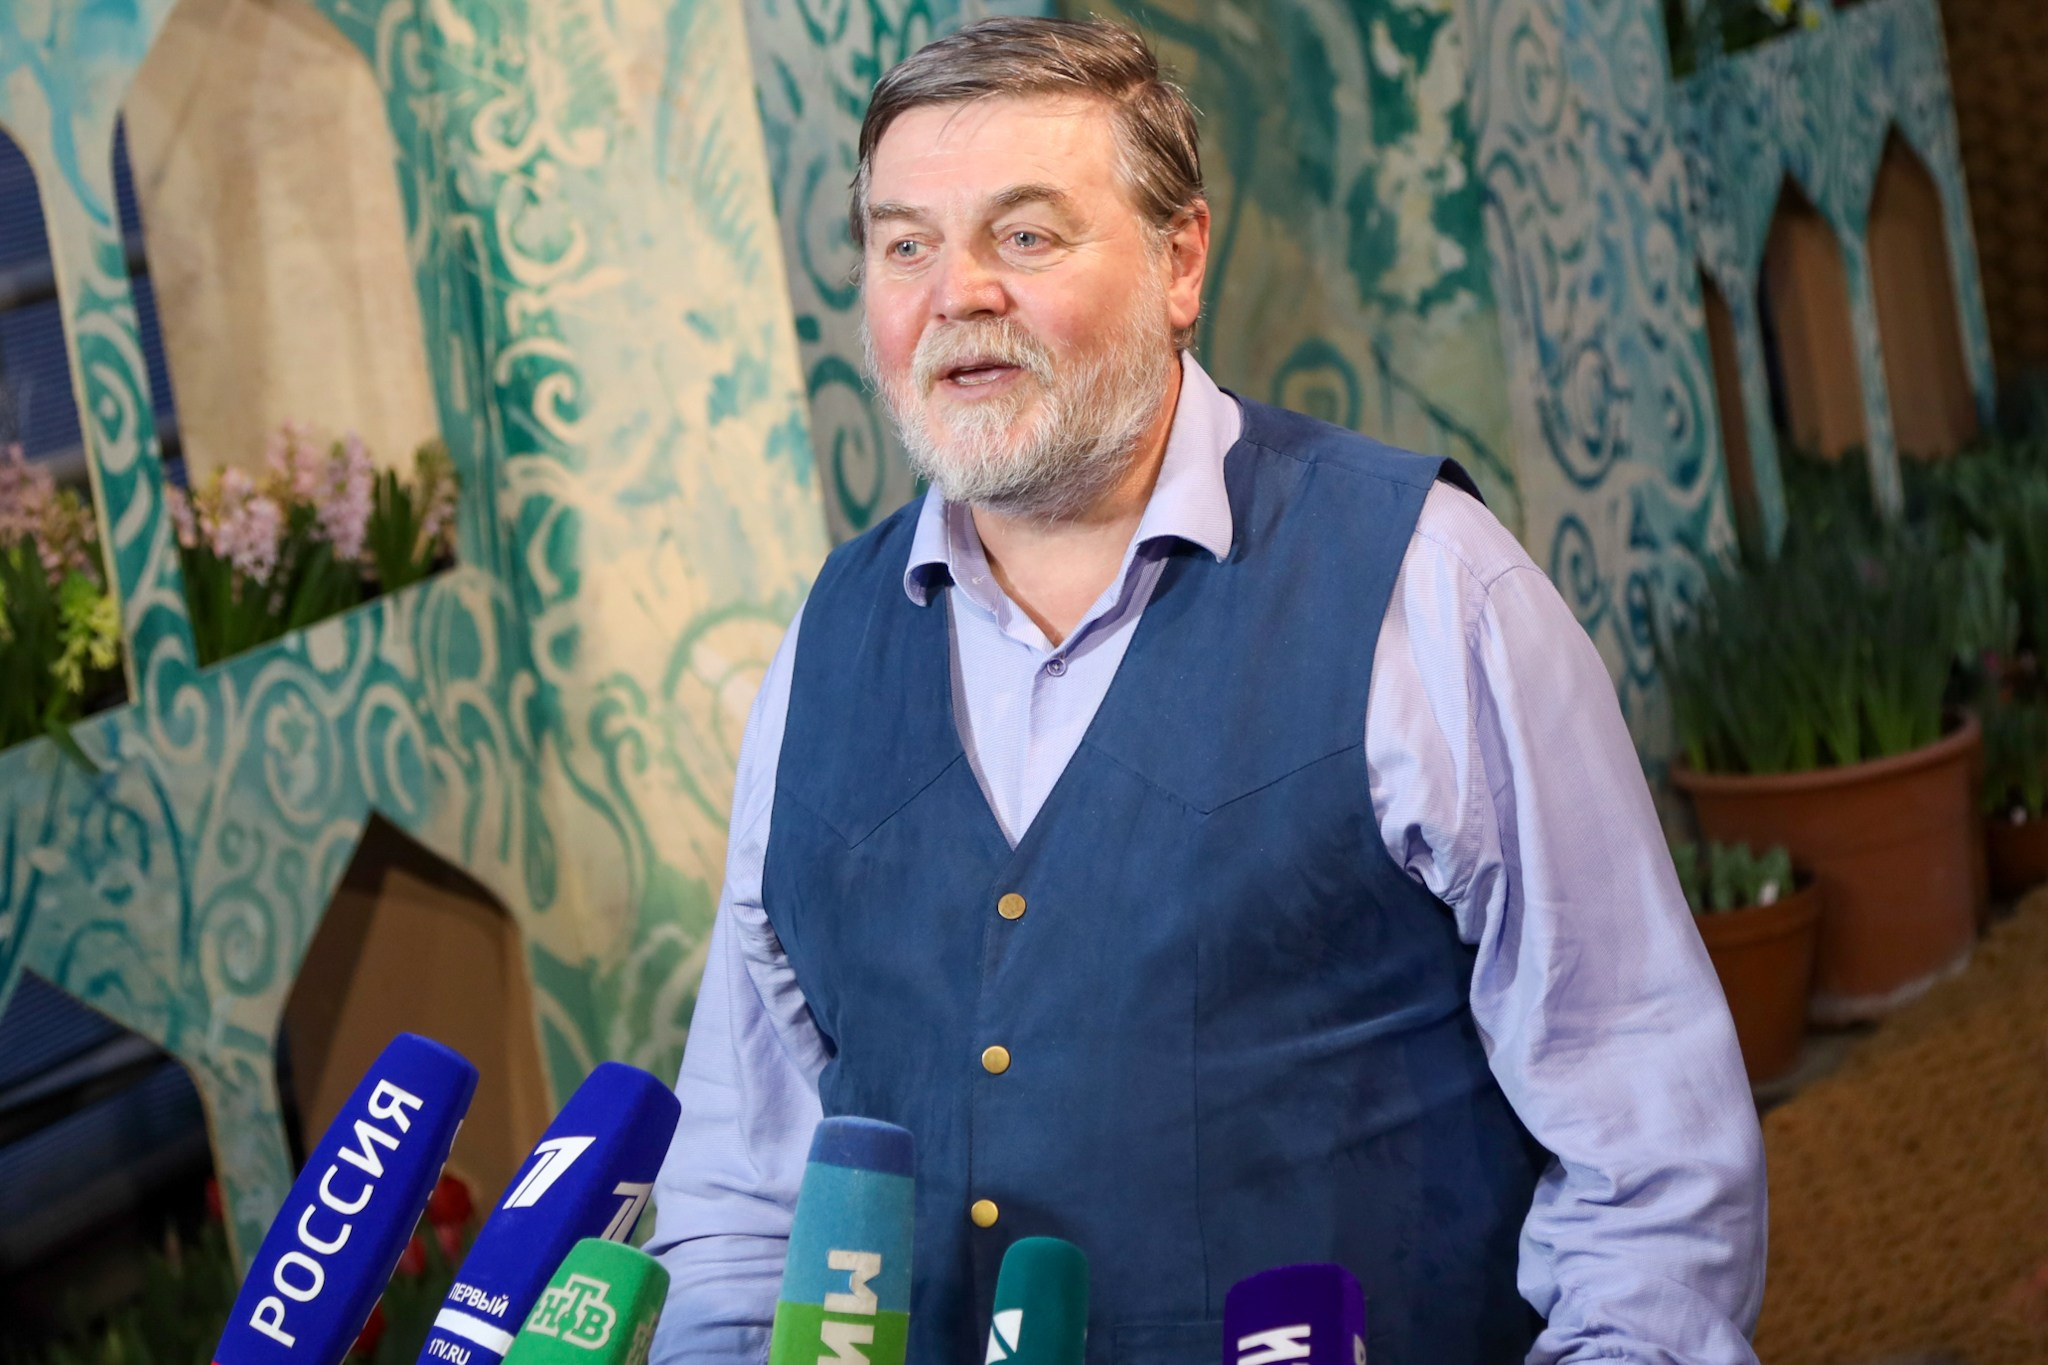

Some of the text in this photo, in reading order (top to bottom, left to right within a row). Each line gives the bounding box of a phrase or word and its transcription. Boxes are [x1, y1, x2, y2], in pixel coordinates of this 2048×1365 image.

[502, 1136, 597, 1210] 1
[249, 1078, 424, 1349] РОССИЯ
[448, 1282, 510, 1318] ПЕРВЫЙ
[526, 1273, 616, 1350] НТВ
[428, 1338, 471, 1365] 1TV.RU
